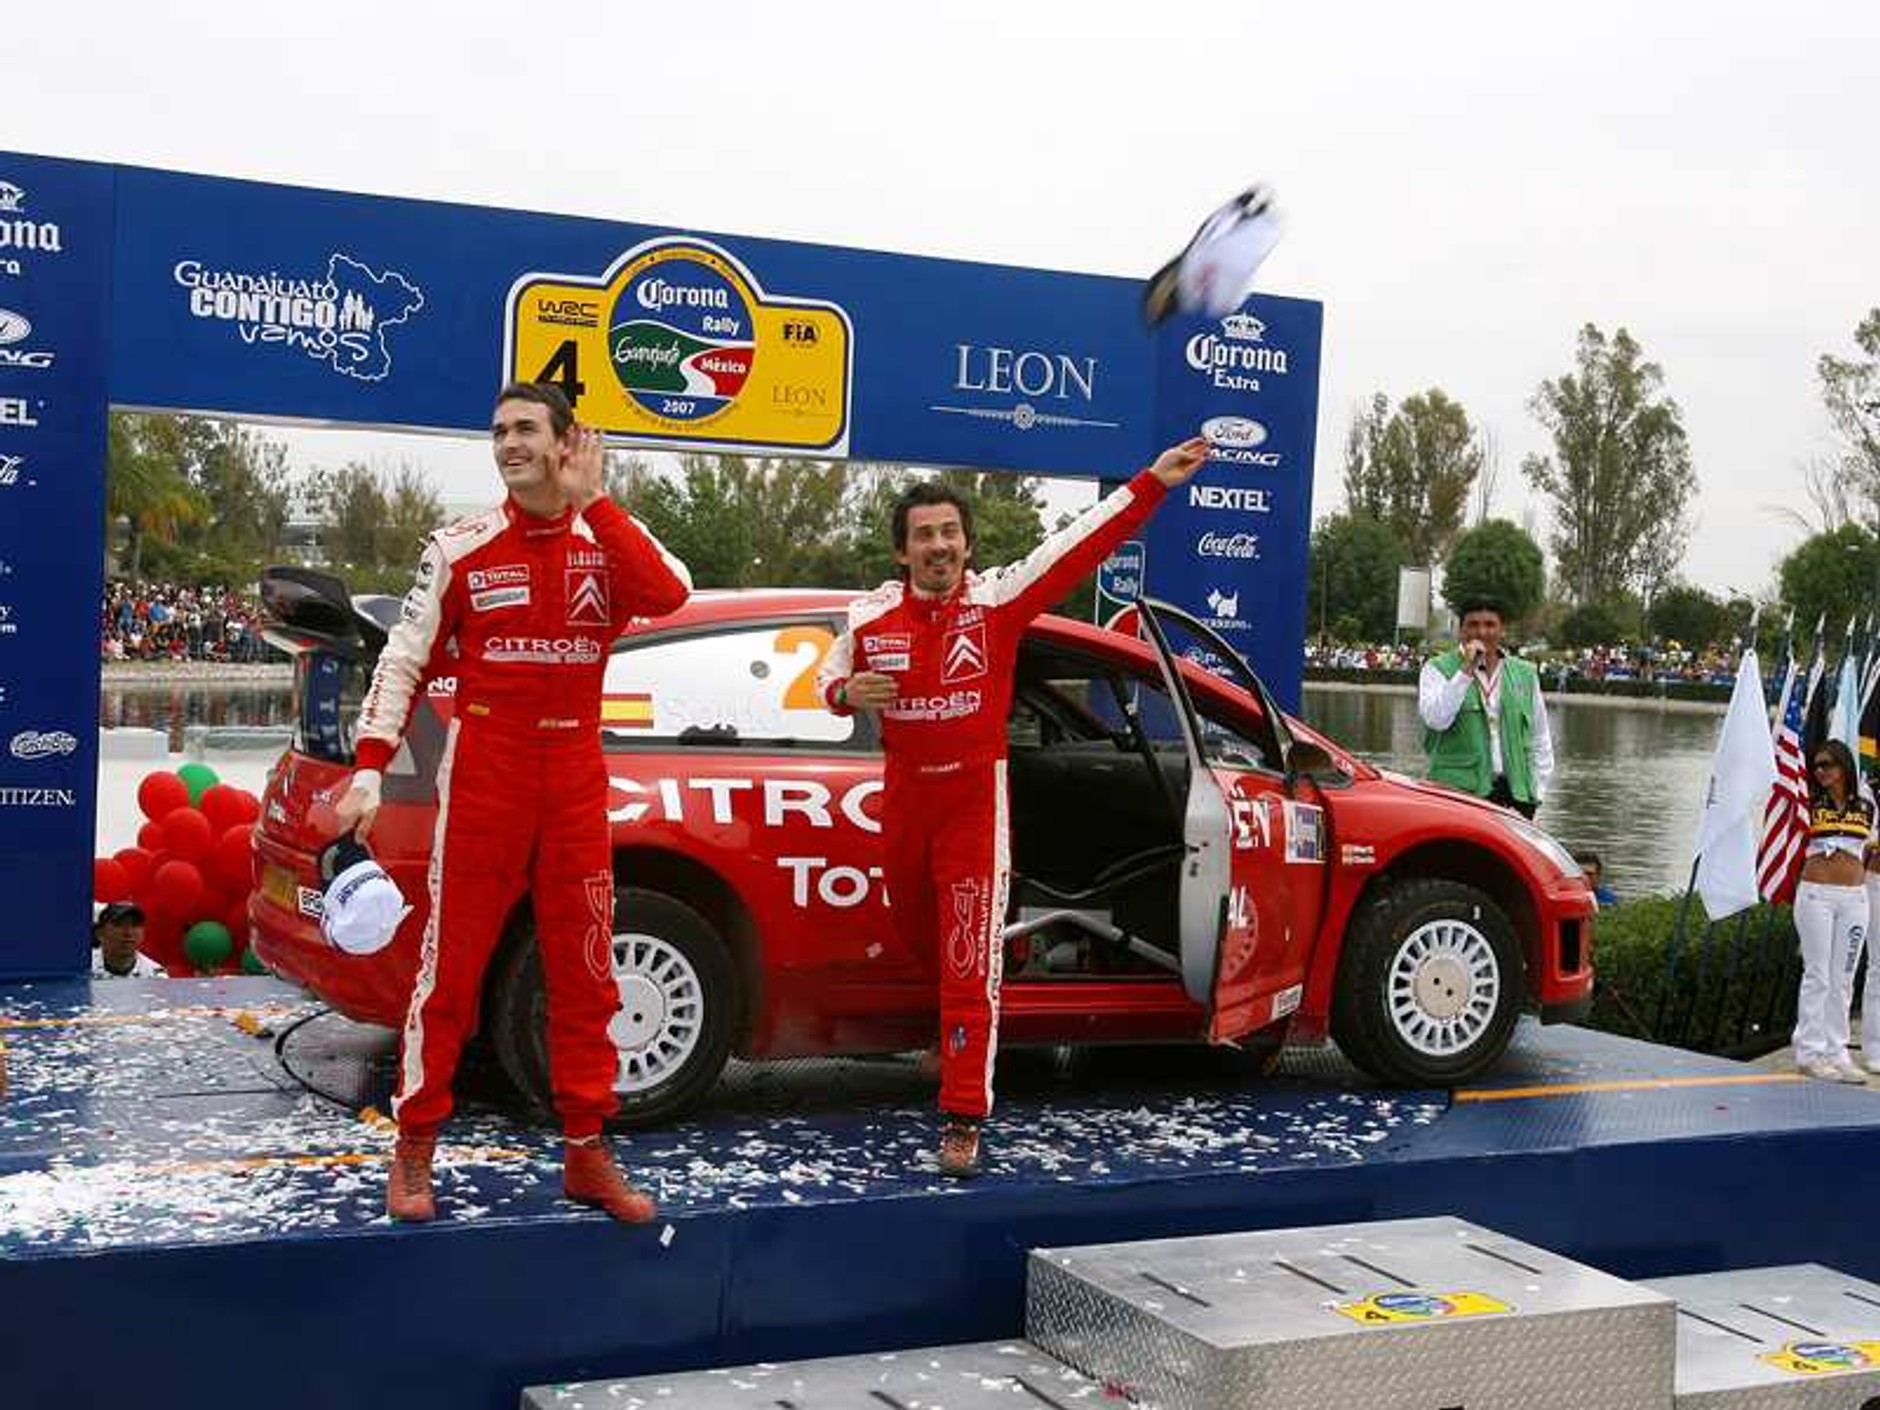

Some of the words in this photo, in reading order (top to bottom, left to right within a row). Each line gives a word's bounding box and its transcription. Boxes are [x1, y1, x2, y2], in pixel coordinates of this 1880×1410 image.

[174, 260, 339, 301] Guanajuato
[636, 278, 728, 313] Corona
[190, 287, 337, 329] CONTIGO
[702, 315, 740, 335] Rally
[240, 323, 371, 361] vamos
[1186, 333, 1288, 375] Corona
[955, 344, 1098, 401] LEON
[1214, 368, 1260, 392] Extra
[662, 400, 696, 415] 2007
[1209, 448, 1282, 467] ACING
[1190, 485, 1270, 512] NEXTEL
[774, 625, 838, 710] 2
